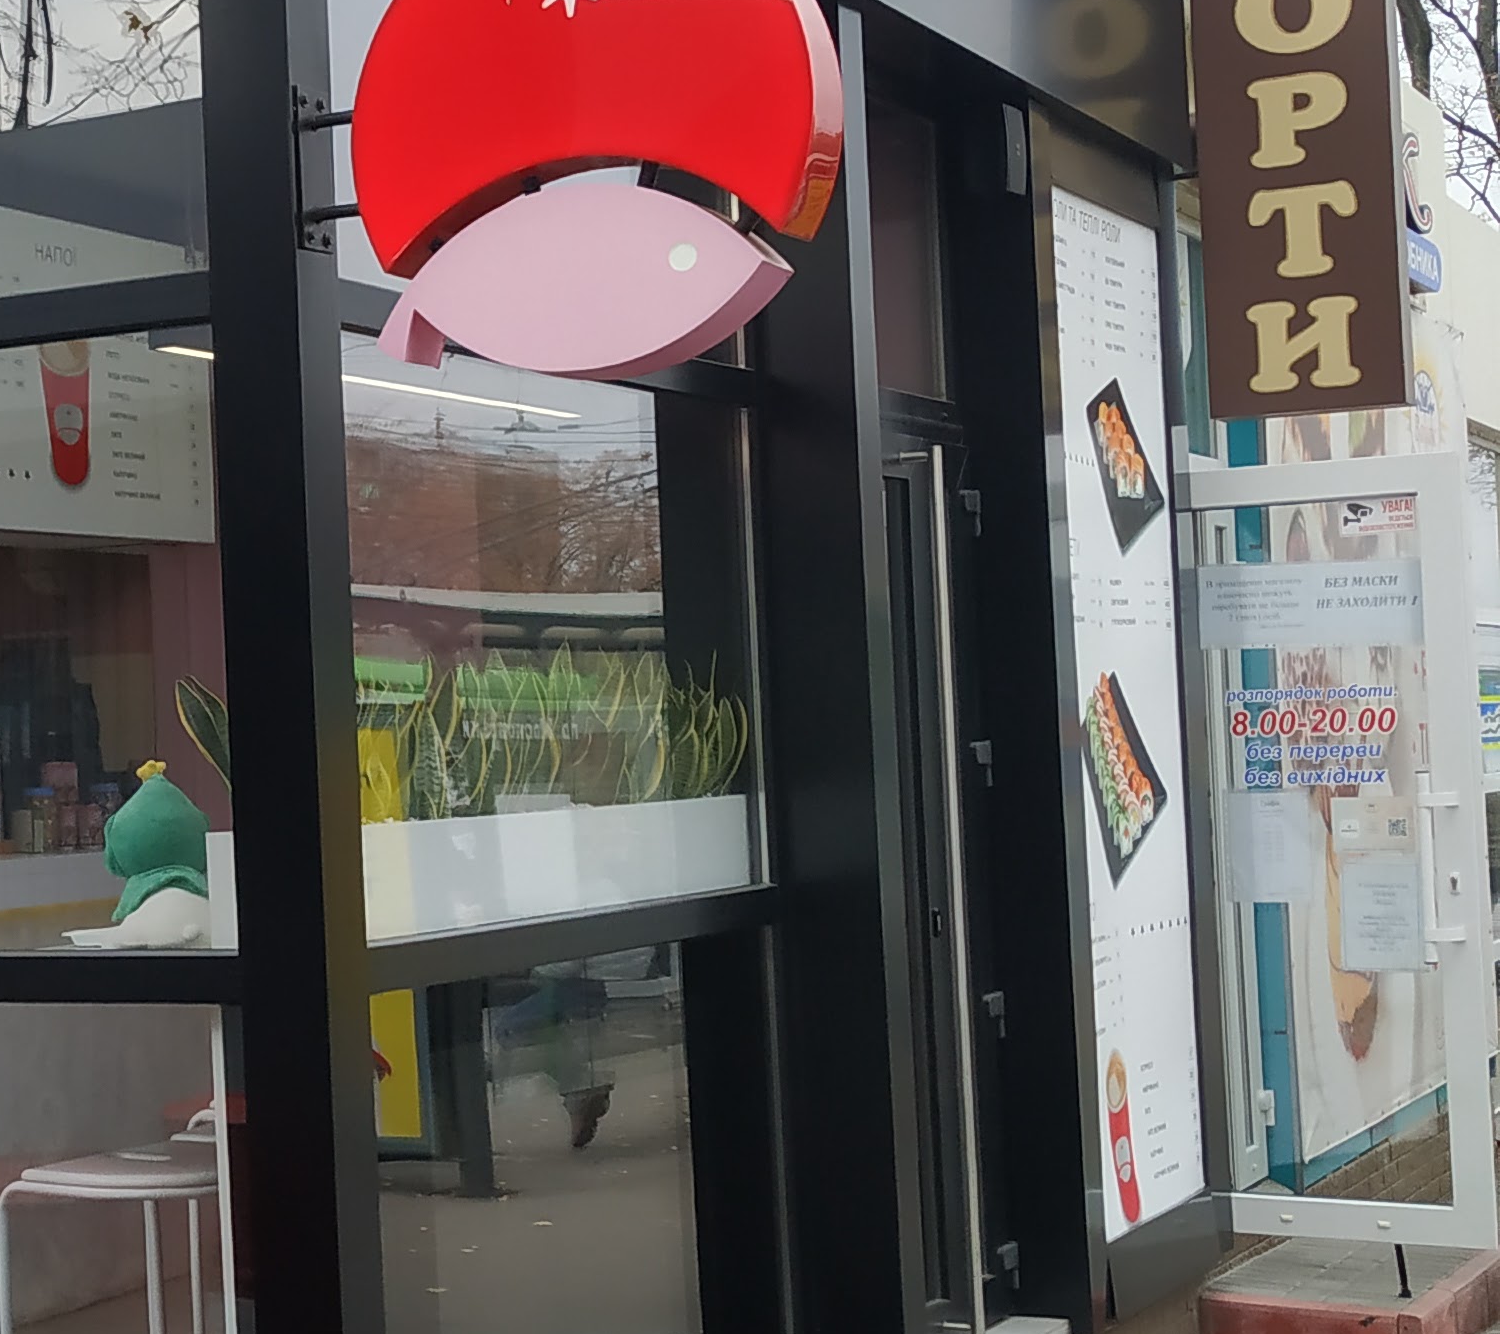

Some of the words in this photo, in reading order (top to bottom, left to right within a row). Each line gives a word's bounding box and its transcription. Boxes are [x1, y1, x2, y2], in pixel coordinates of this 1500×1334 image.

[1380, 498, 1414, 514] УВАГА!
[1324, 577, 1348, 589] БЕЗ
[1351, 574, 1399, 587] МАСКИ
[1316, 597, 1335, 609] НЕ
[1336, 595, 1407, 609] ЗАХОДИТИ
[1226, 686, 1323, 704] розпорядок
[1231, 706, 1397, 737] 8.00-20.00
[1246, 741, 1283, 760] без
[1289, 744, 1382, 762] перерви
[1244, 767, 1280, 785] без
[1287, 765, 1386, 785] вихідних
